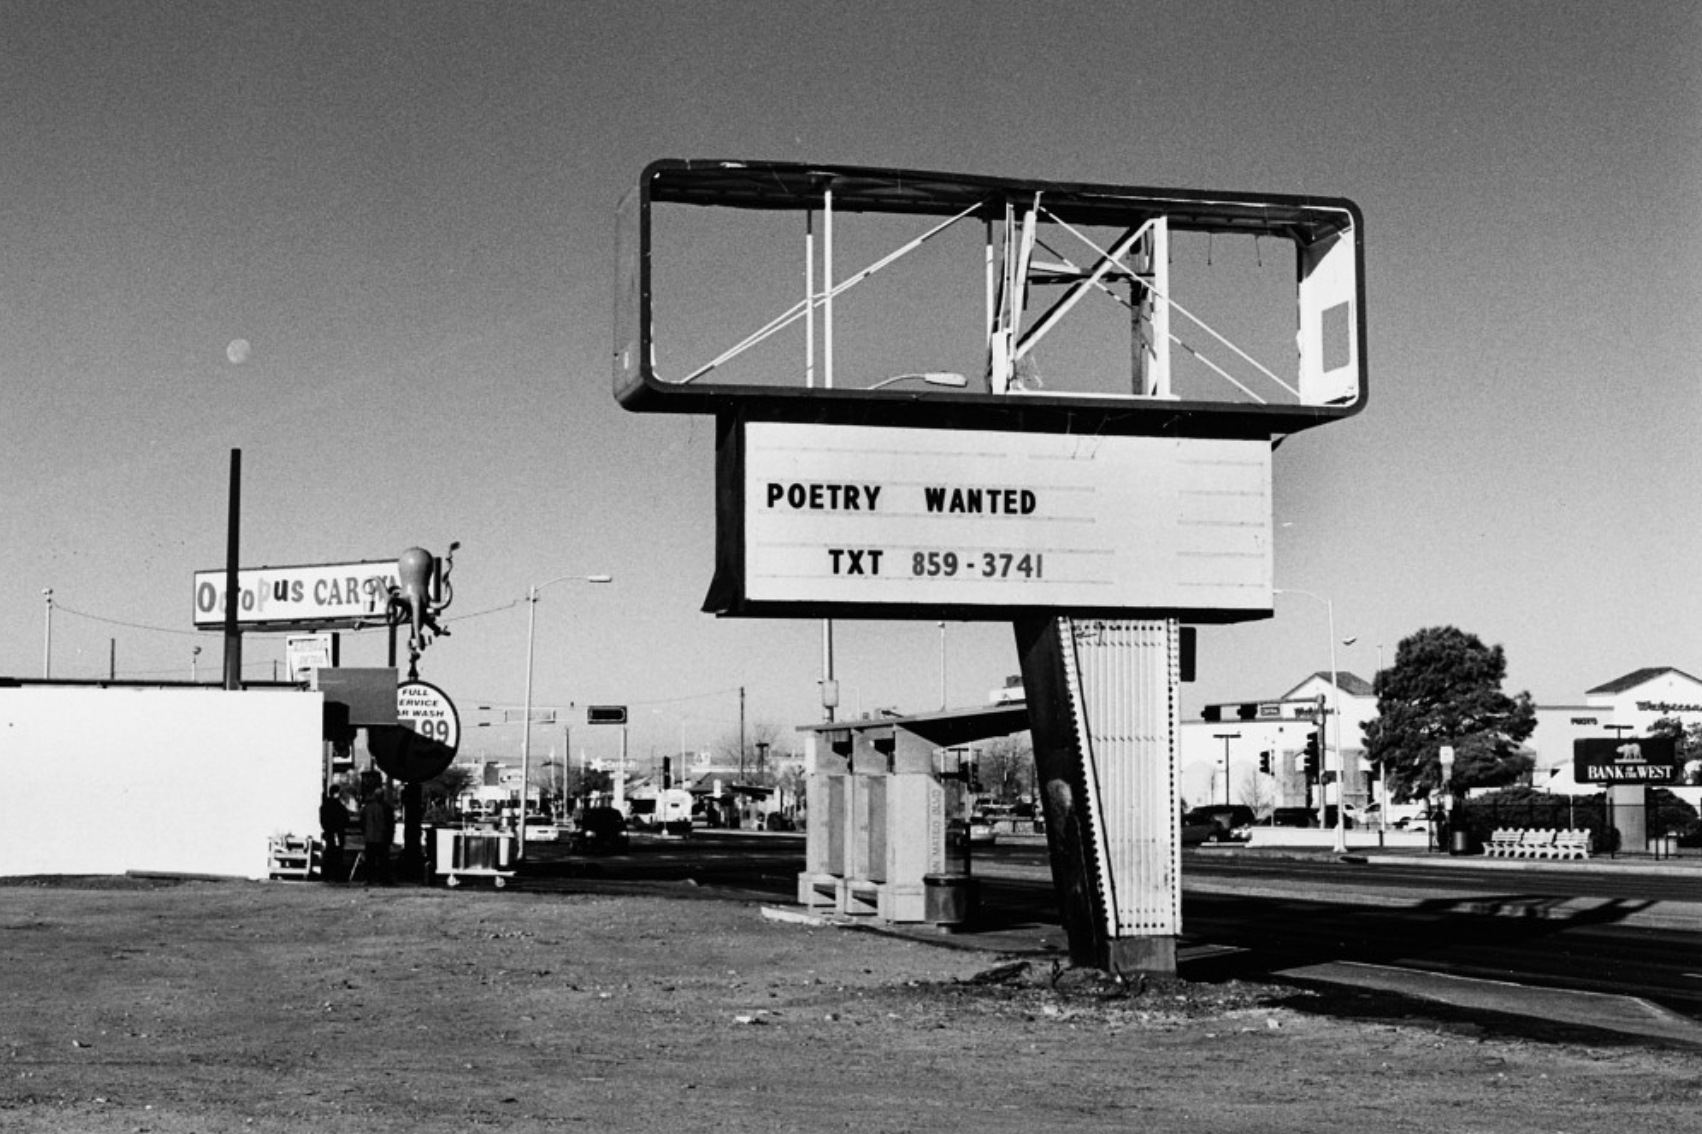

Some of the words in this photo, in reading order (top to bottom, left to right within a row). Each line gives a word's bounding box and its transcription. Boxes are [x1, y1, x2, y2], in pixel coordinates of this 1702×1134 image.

[767, 483, 881, 511] POETRY
[925, 487, 1036, 514] WANTED
[828, 549, 883, 575] TXT
[912, 552, 1042, 578] 859-3741
[314, 577, 360, 606] CAR
[1587, 765, 1624, 779] BANK
[1637, 765, 1674, 779] WEST
